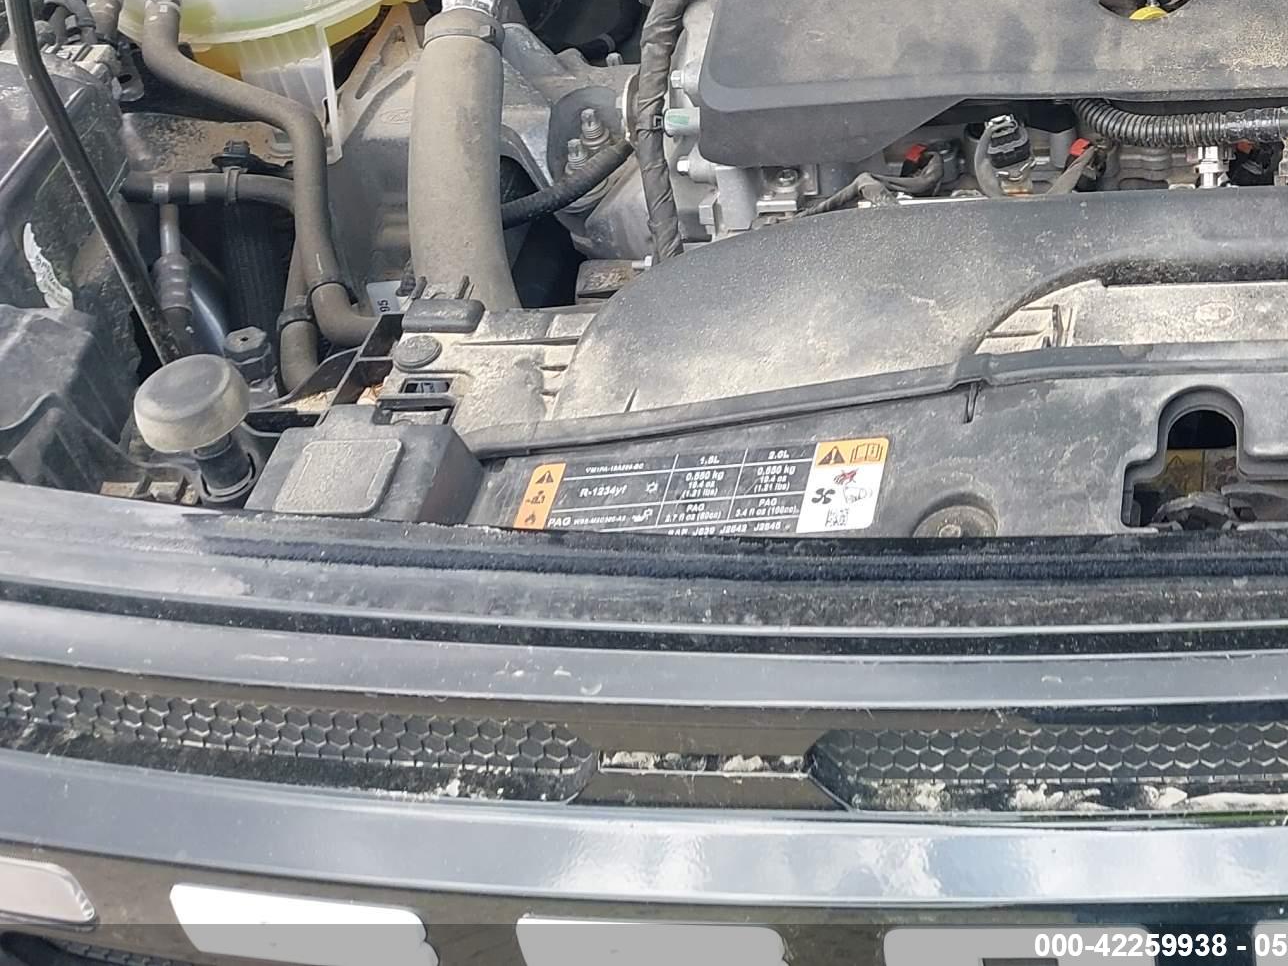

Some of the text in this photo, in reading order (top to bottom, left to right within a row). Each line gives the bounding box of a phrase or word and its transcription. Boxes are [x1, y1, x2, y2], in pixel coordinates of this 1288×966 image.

[784, 465, 796, 475] kg
[712, 471, 724, 481] kg
[580, 485, 627, 497] R-1234yf
[687, 503, 705, 512] PAG
[759, 498, 777, 507] PAG
[548, 516, 571, 527] PAG
